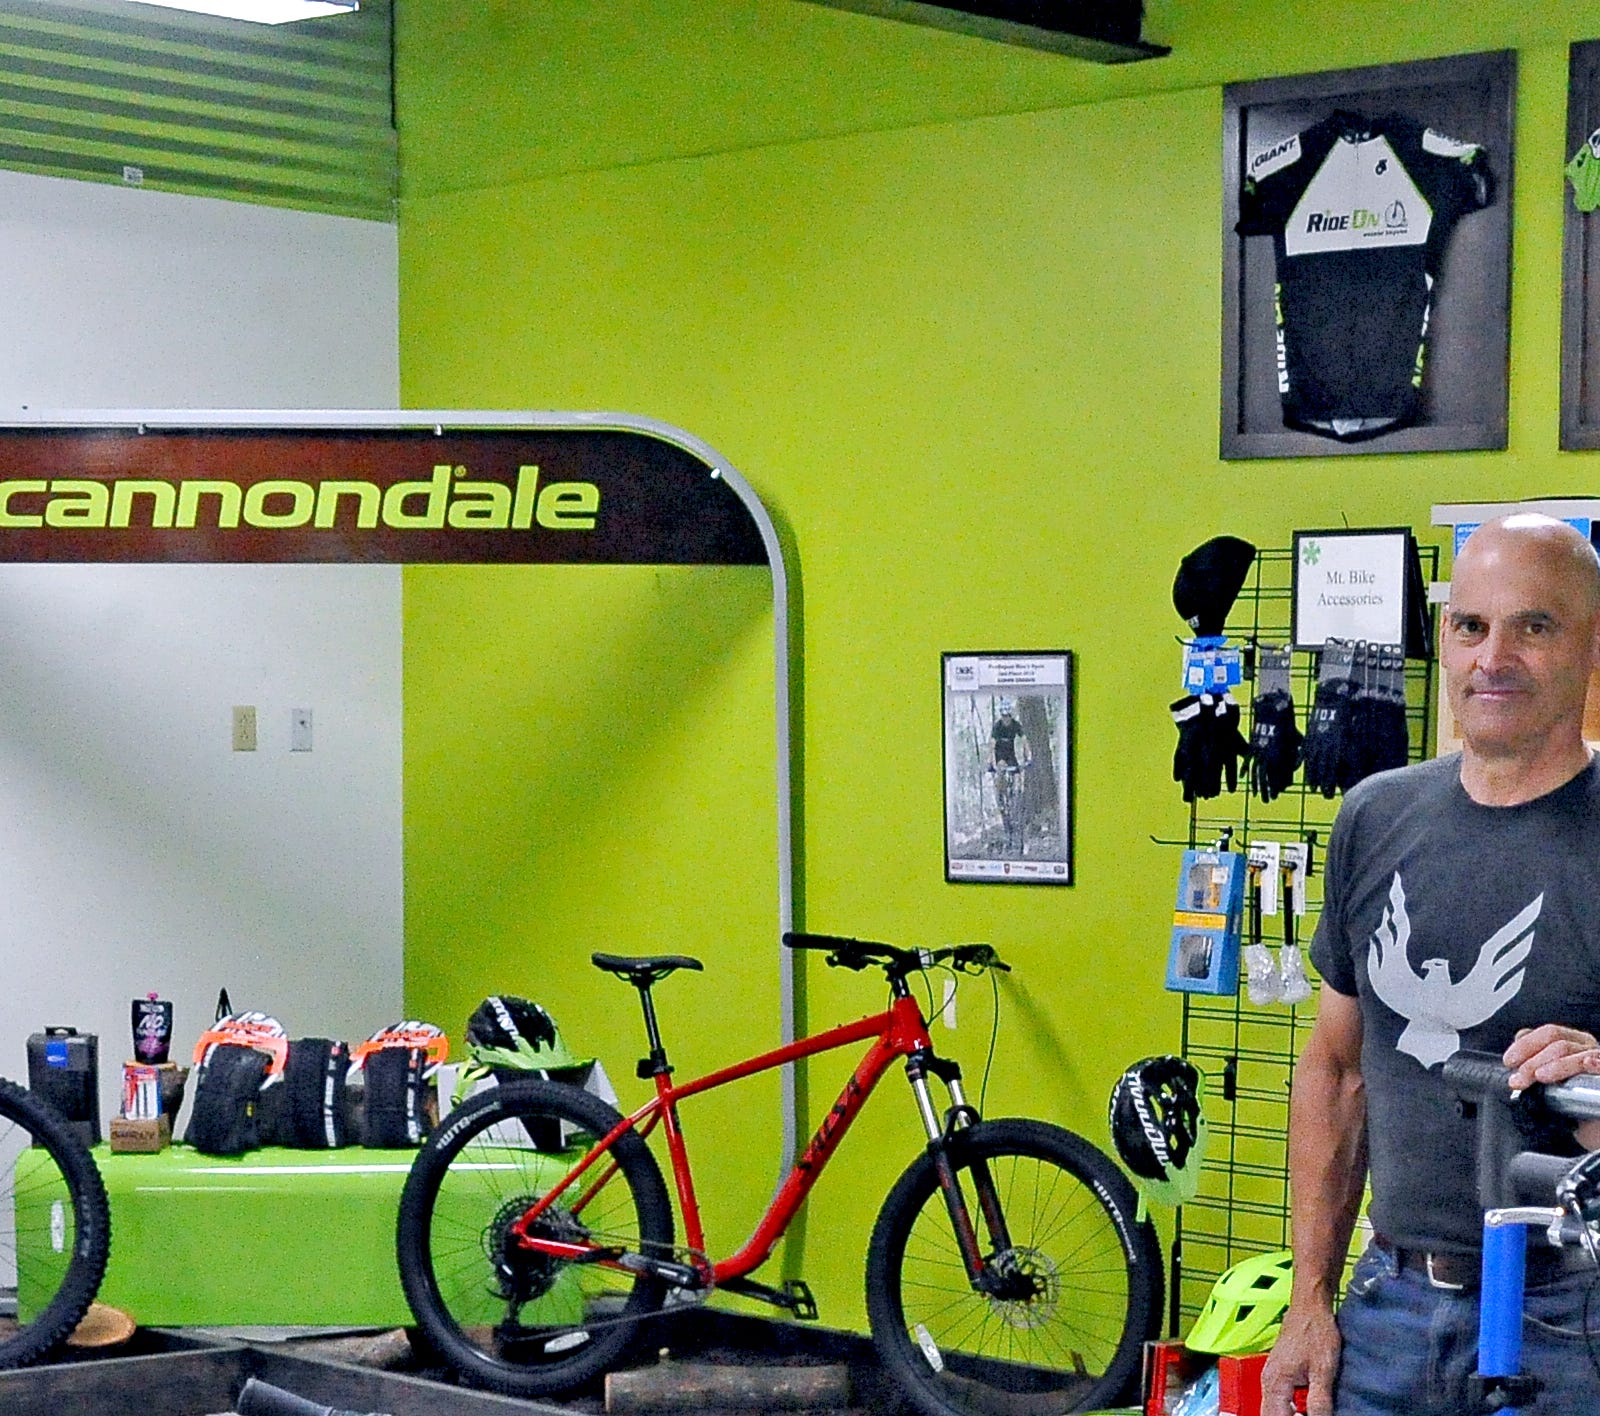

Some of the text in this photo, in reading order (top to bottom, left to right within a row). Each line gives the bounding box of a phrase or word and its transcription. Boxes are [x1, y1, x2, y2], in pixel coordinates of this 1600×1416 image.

[1254, 137, 1297, 168] GIANT
[0, 465, 600, 531] cannondale
[1326, 571, 1376, 586] Mt. Bike
[1317, 591, 1383, 607] Accessories
[1255, 723, 1276, 737] FOX
